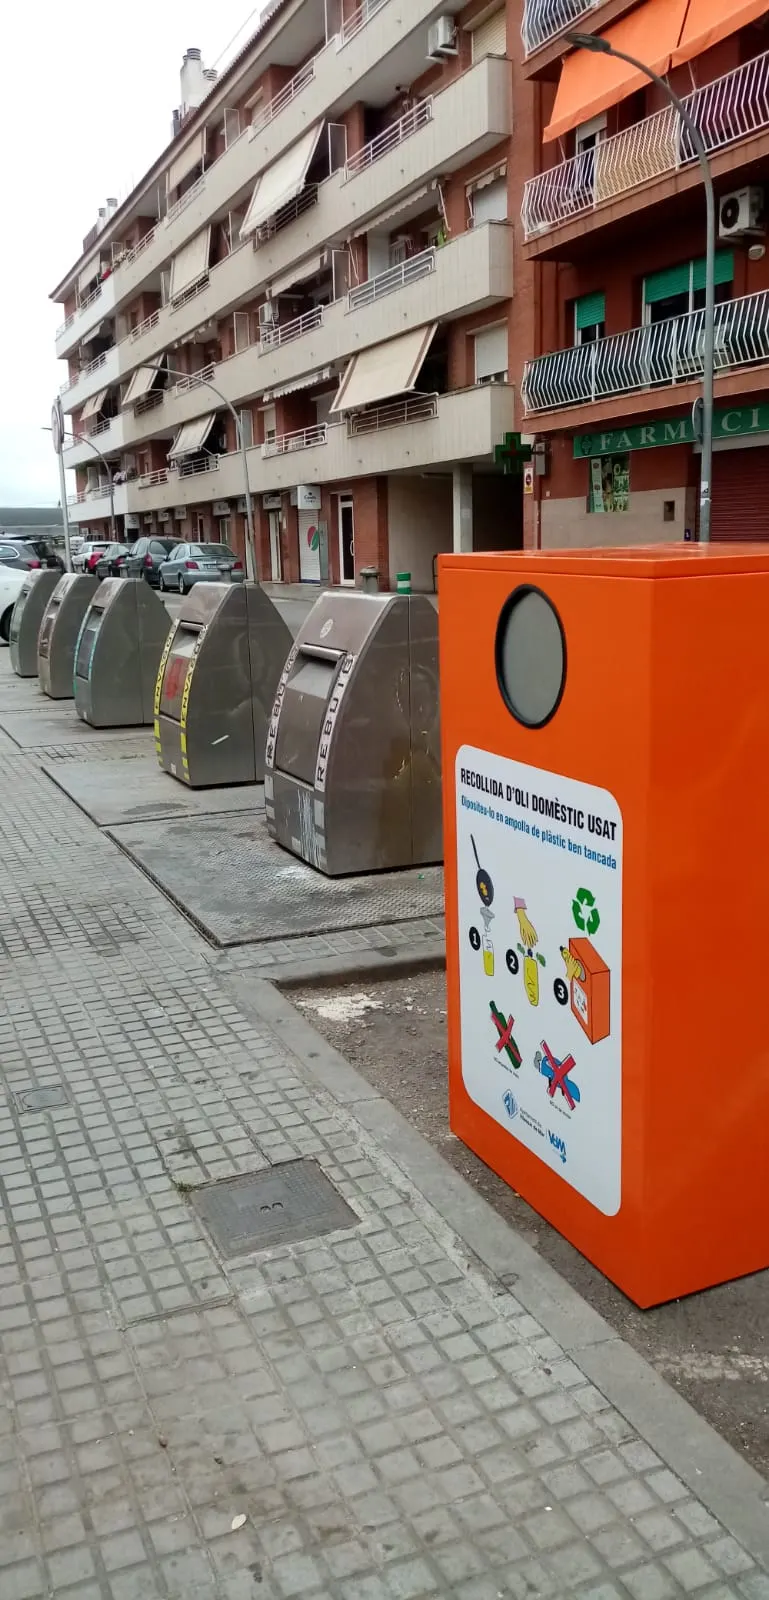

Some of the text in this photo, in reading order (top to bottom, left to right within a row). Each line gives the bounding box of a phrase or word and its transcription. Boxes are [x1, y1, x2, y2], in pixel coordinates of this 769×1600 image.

[600, 408, 769, 450] FARMCI
[317, 653, 354, 783] REBUIG
[461, 768, 617, 841] RECOLLIDA D'OLI DOMÈSTIC USAT
[496, 811, 504, 823] en
[504, 815, 530, 834] ampolla
[531, 824, 540, 838] de
[541, 829, 566, 849] plàstic
[568, 838, 582, 856] ben
[584, 844, 617, 870] tancada
[509, 955, 516, 969] 2
[557, 984, 565, 999] 3
